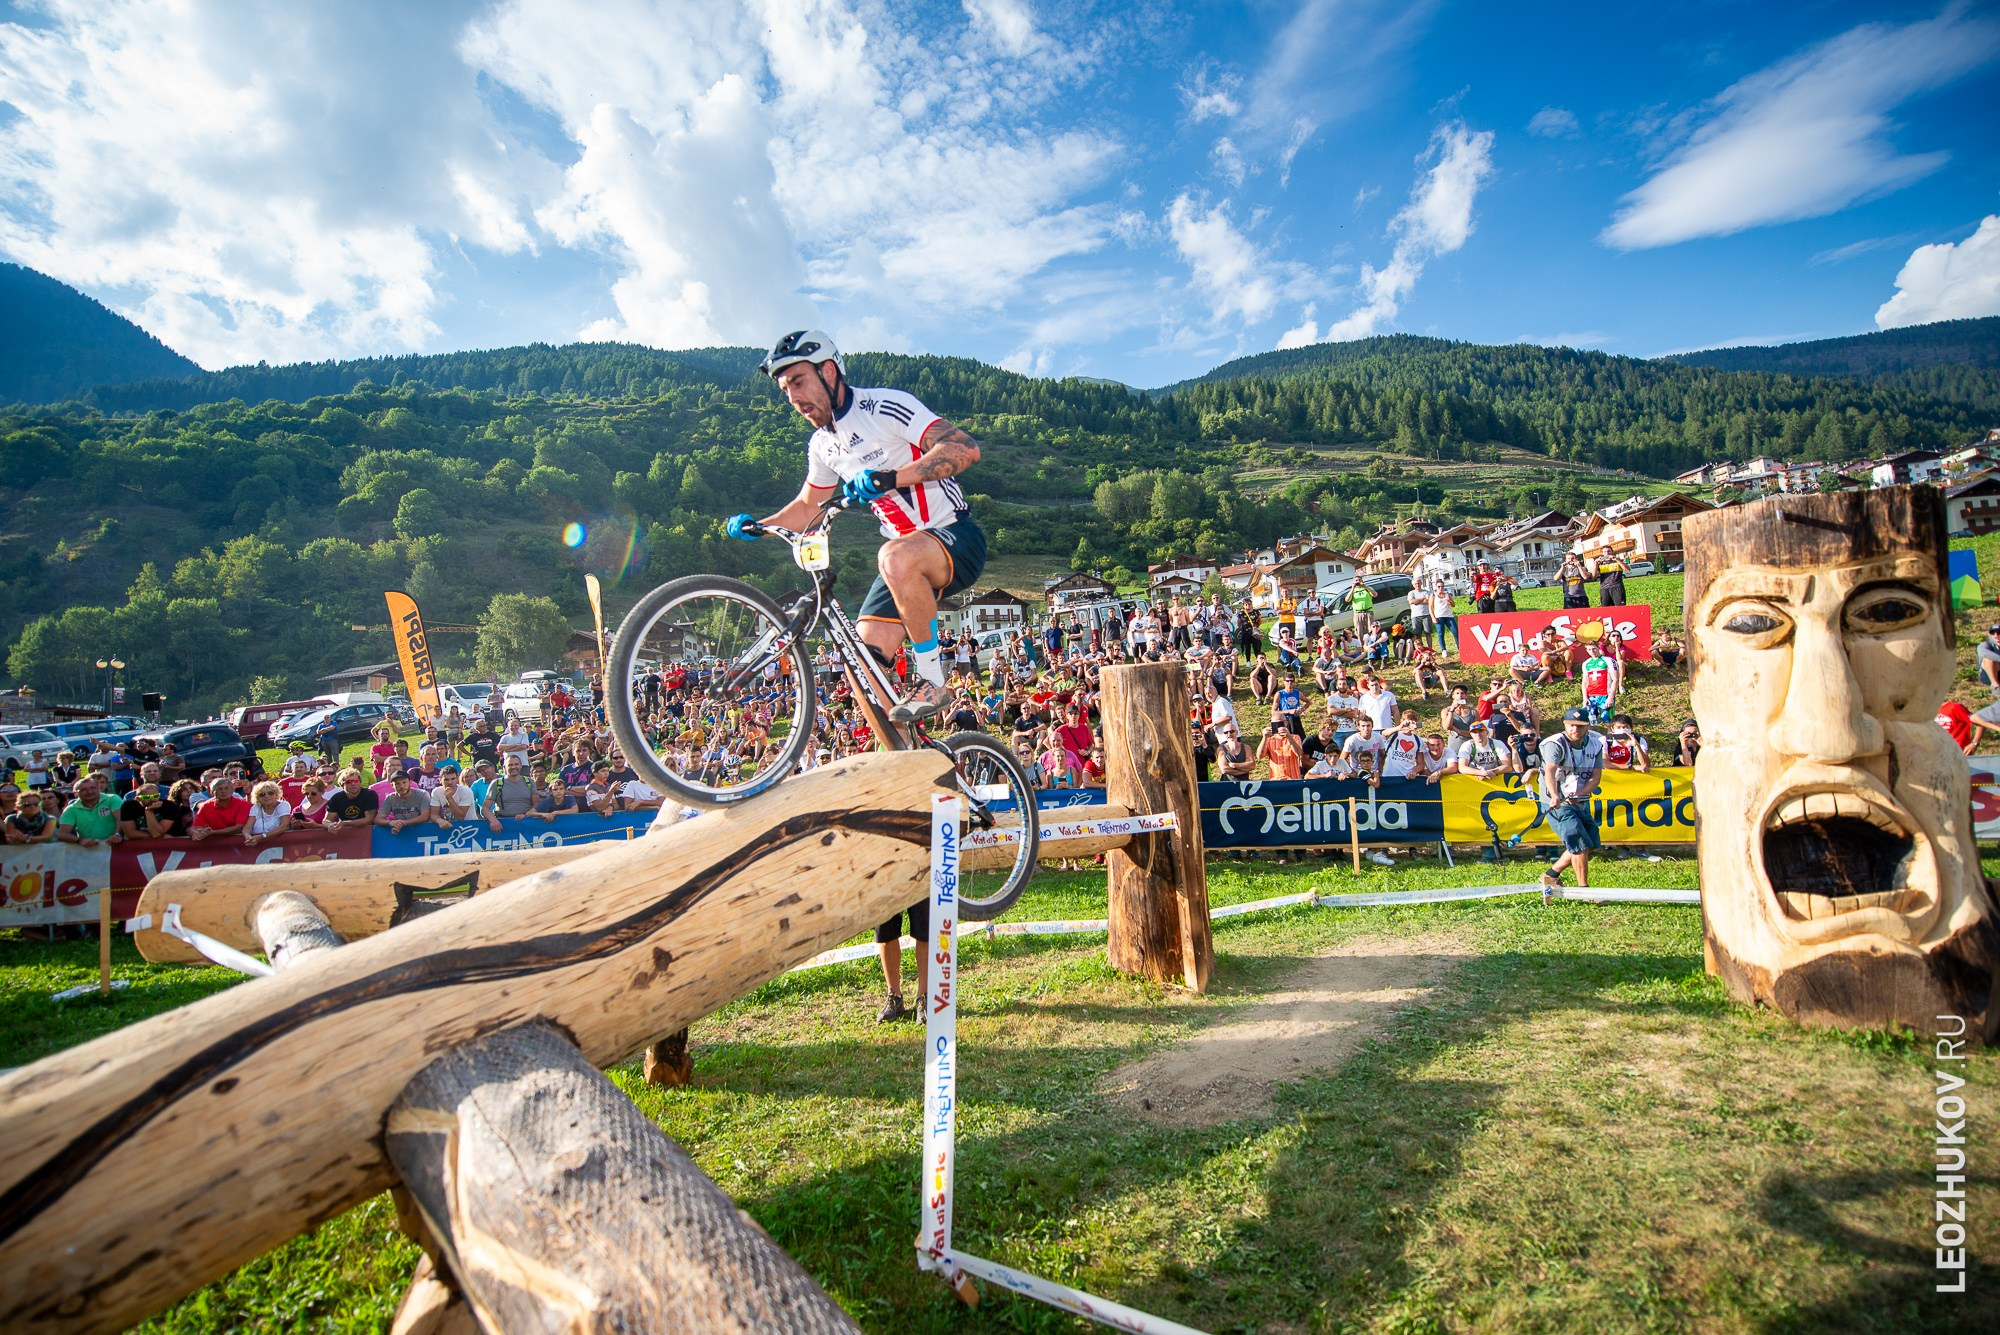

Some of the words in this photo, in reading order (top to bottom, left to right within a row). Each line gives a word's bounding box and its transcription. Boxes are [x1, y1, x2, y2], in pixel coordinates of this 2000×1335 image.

[1470, 622, 1523, 658] Val
[1097, 822, 1131, 834] TRENTINO
[1219, 786, 1408, 834] Melinda
[1058, 826, 1072, 837] Val
[1076, 825, 1095, 836] Sole
[938, 822, 957, 906] TRENTINO
[936, 918, 952, 965] Sole
[943, 966, 951, 979] di
[934, 981, 951, 1014] Val
[933, 1036, 951, 1139] TRENTINO
[932, 1152, 946, 1210] Sole
[938, 1210, 946, 1224] di
